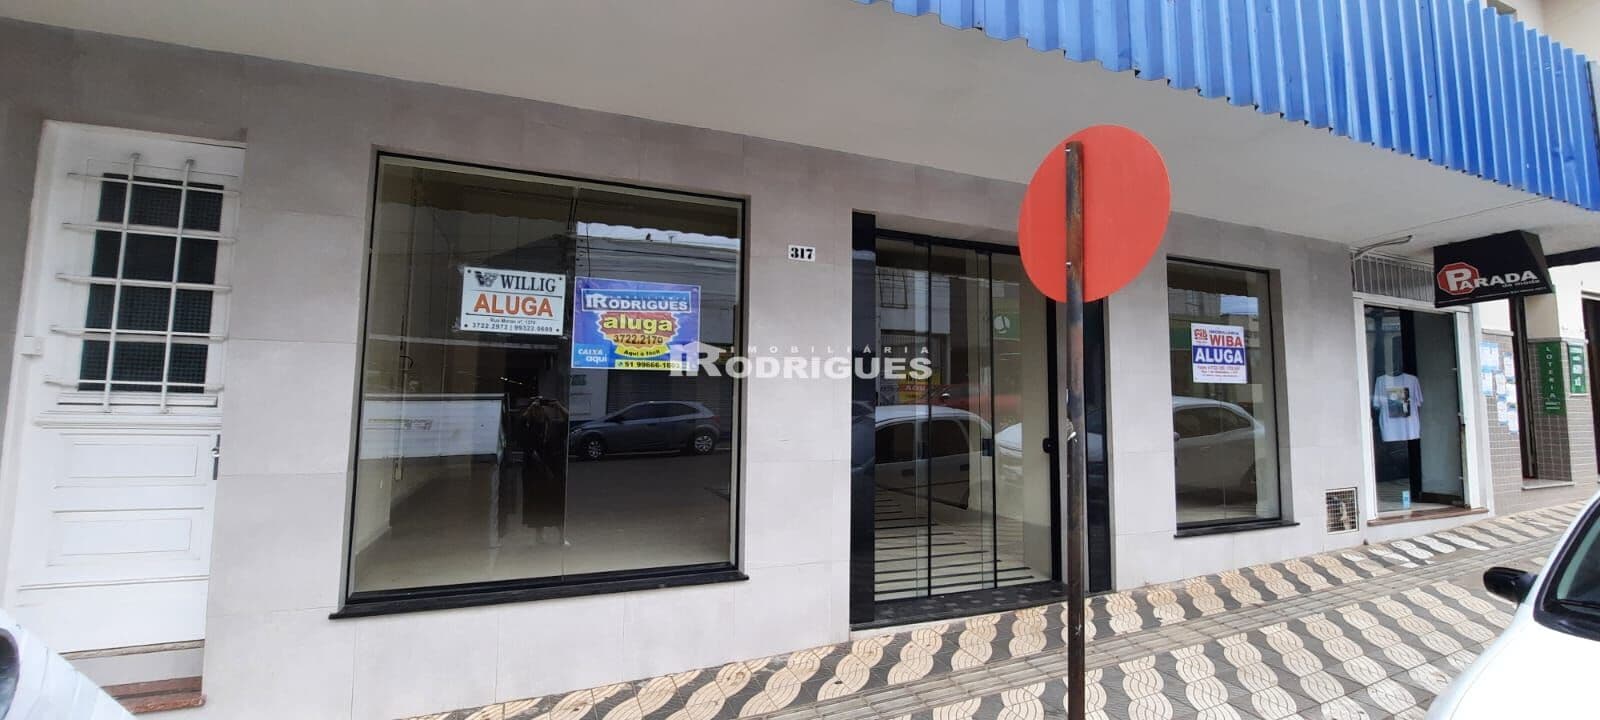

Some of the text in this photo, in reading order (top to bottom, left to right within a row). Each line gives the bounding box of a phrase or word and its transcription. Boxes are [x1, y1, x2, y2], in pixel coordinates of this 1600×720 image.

[791, 247, 813, 259] 317
[500, 274, 556, 292] WILLIG
[1445, 268, 1538, 291] PARADA
[473, 293, 553, 317] ALUGA
[603, 314, 673, 334] aluga
[1210, 335, 1242, 347] WIBA
[578, 348, 603, 356] CAIXA
[586, 354, 607, 364] aqui
[1195, 348, 1244, 364] ALUGA
